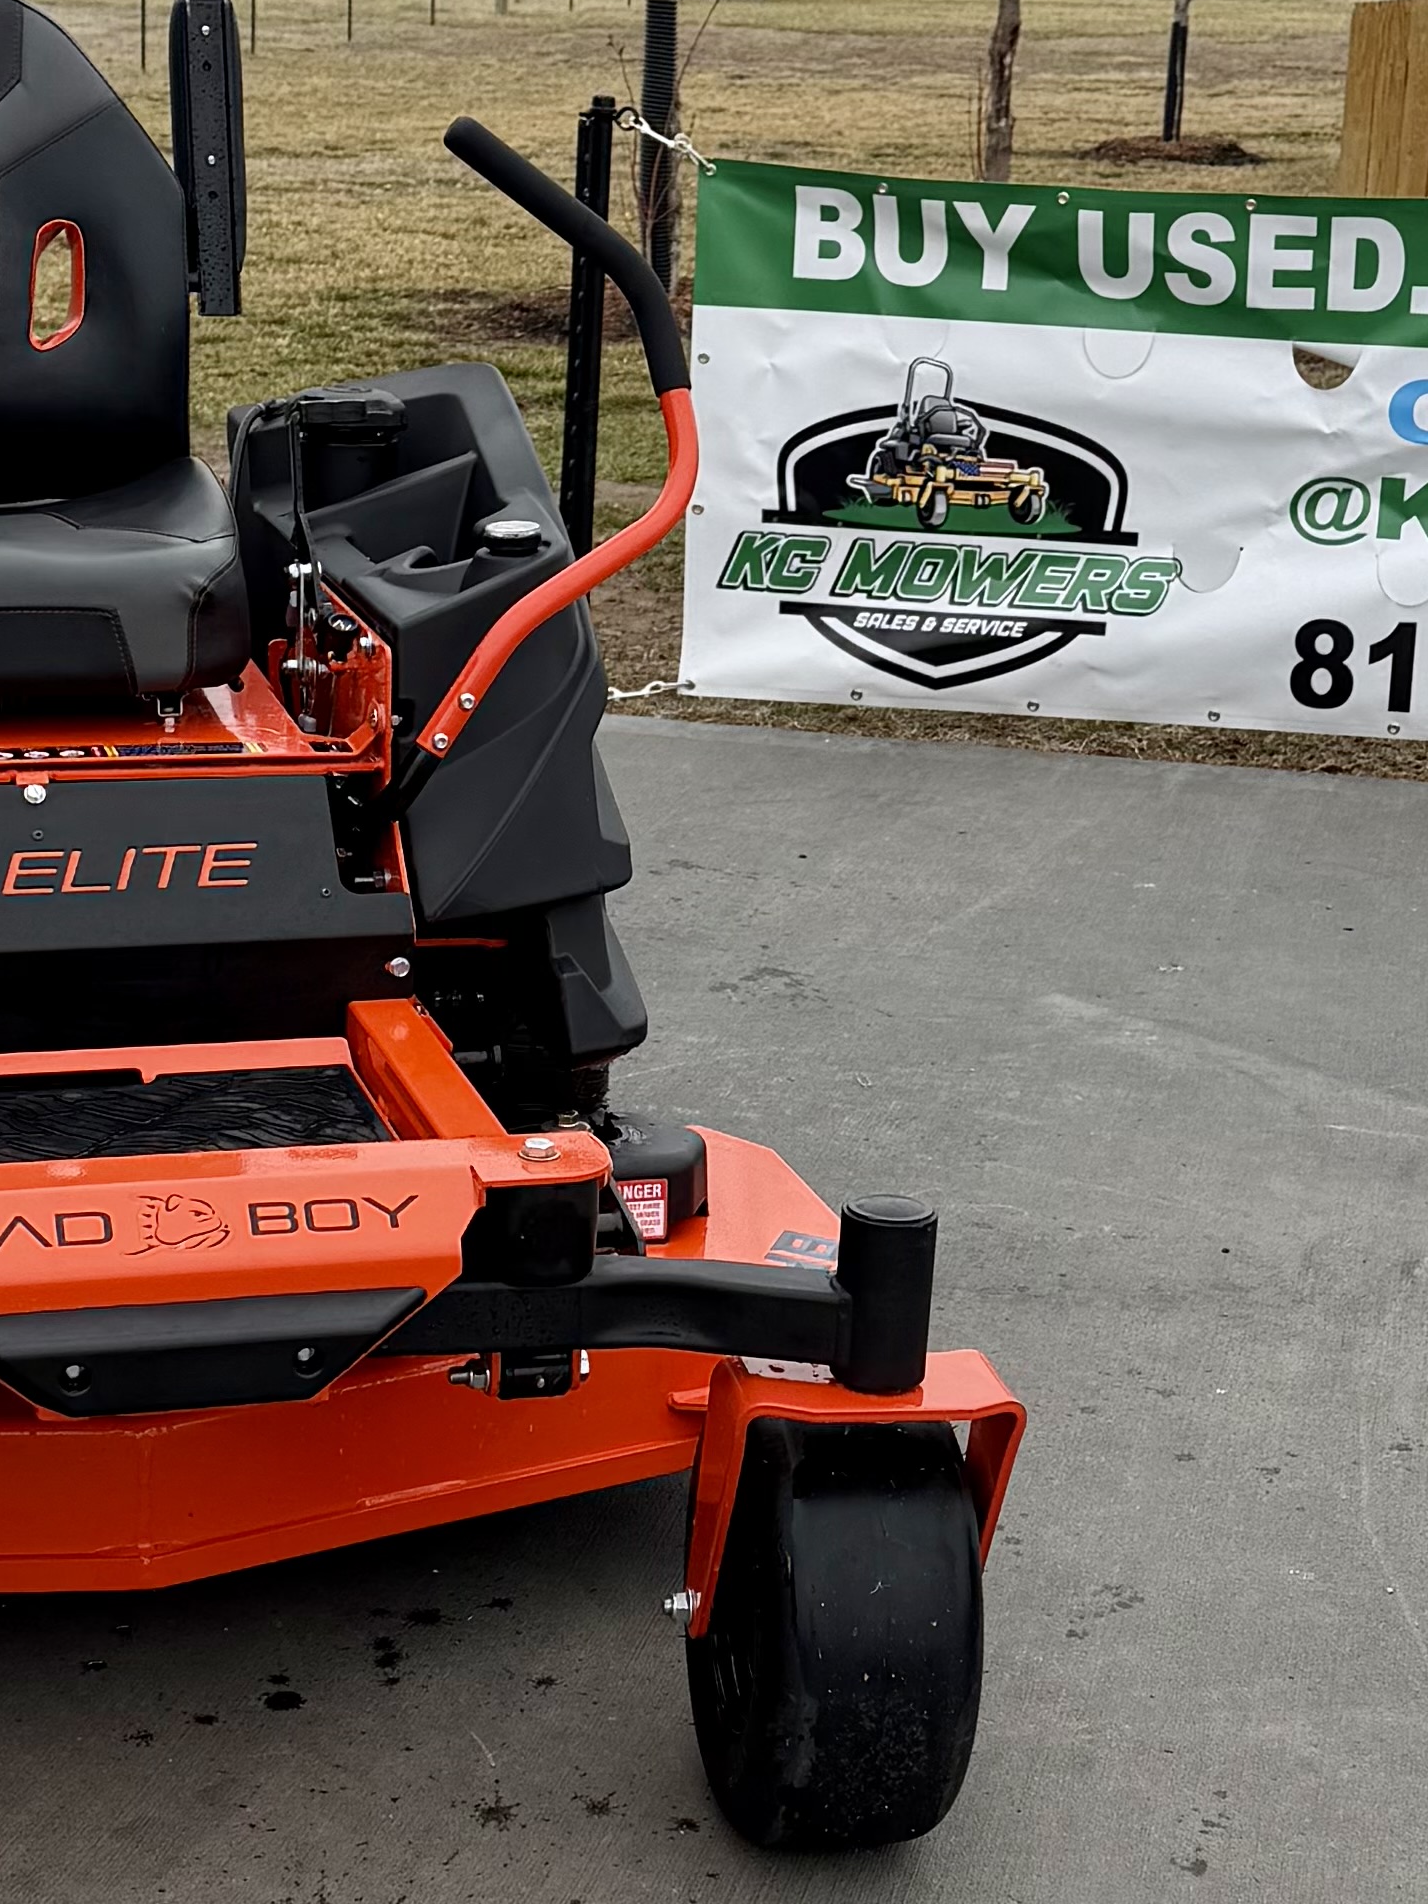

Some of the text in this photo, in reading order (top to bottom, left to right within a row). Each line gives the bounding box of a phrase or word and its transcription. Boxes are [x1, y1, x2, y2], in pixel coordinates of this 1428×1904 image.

[792, 184, 1036, 291] BUY
[716, 530, 1183, 617] KC MOWERS
[853, 612, 1028, 638] SALES & SERVICE
[1, 842, 259, 895] ELITE
[247, 1194, 419, 1236] BOY
[617, 1183, 662, 1200] NGER
